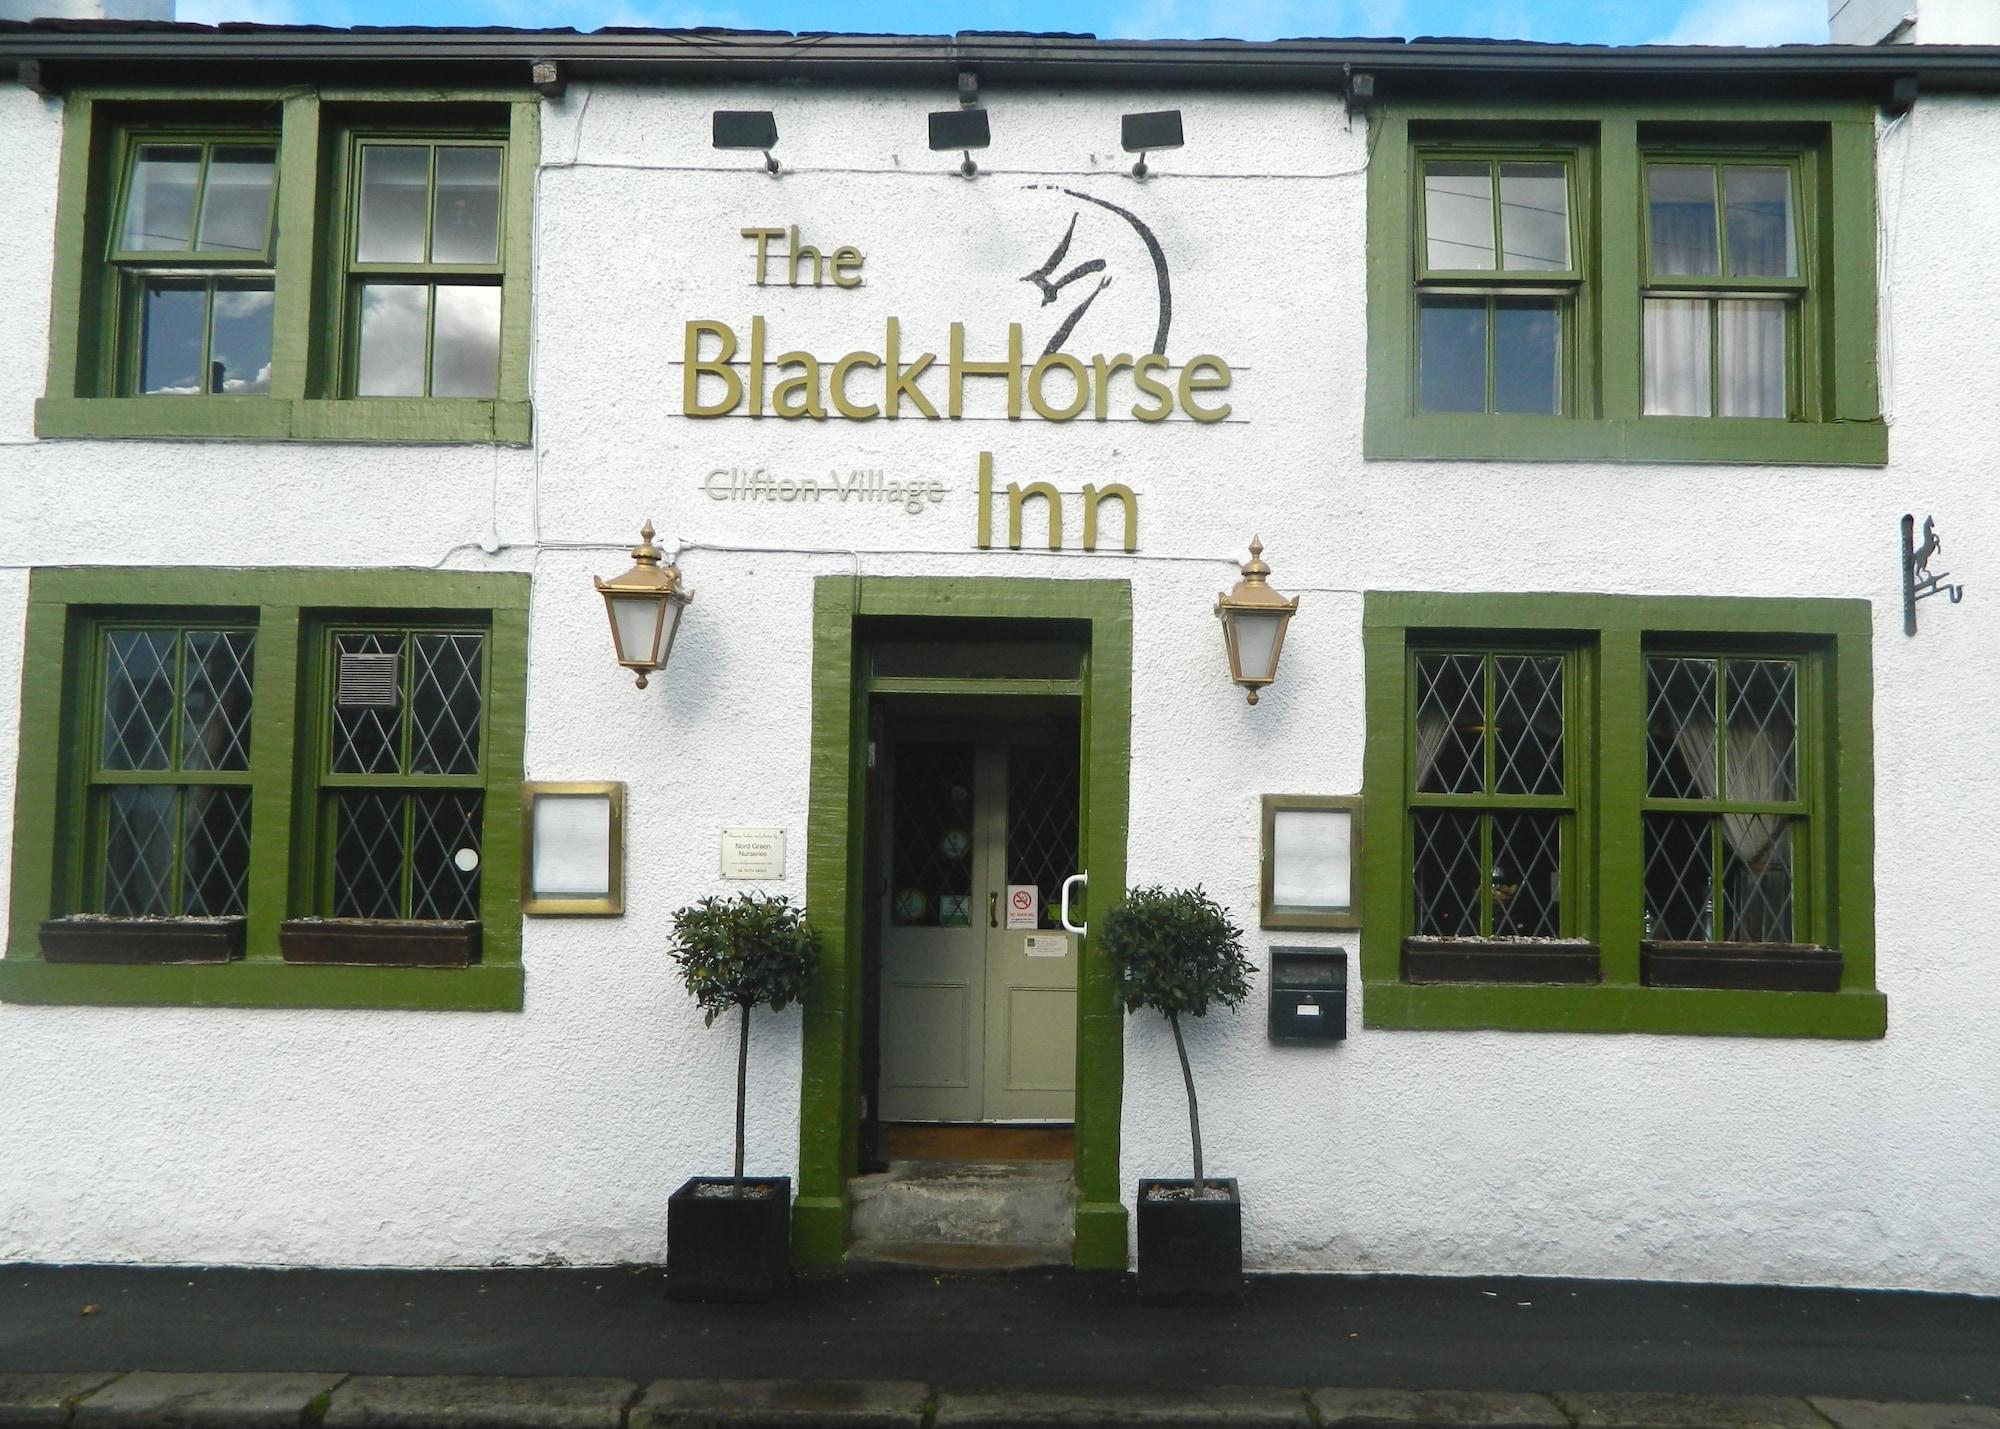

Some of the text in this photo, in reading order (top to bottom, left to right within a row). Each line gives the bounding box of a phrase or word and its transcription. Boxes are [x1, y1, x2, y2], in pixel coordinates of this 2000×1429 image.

[741, 224, 864, 289] The
[704, 467, 944, 515] Clifton Village
[977, 451, 1138, 554] Inn
